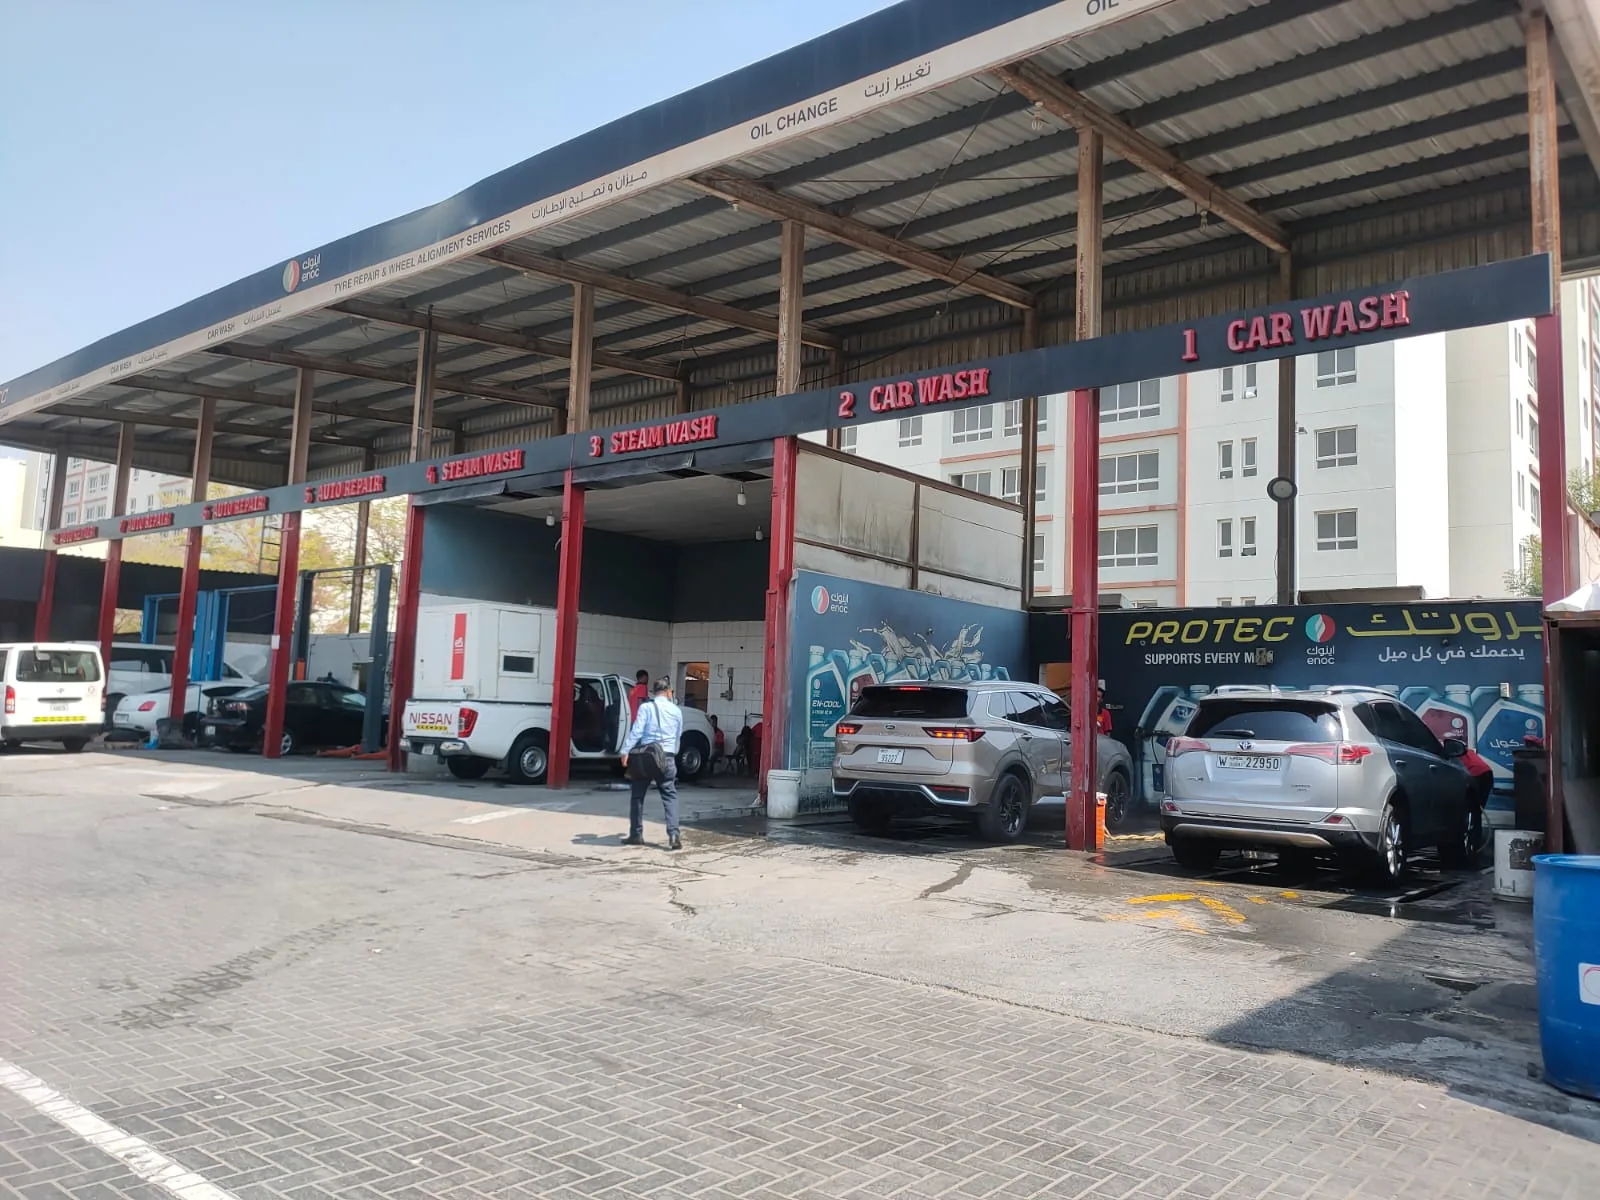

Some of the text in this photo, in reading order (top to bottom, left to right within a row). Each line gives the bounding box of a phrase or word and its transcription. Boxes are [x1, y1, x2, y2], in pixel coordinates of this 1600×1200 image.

[864, 61, 931, 98] تغيير زيت
[750, 97, 838, 140] OIL CHANGE
[334, 220, 511, 293] TYRE REPAIR & WHEEL ALIGNMENT SERVICES
[302, 268, 319, 282] enoc
[207, 322, 235, 340] CAR WASH
[1182, 290, 1410, 361] 1 CAR WASH
[838, 368, 990, 418] 2 CAR WASH
[589, 415, 717, 457] 3 STEAM WASH
[441, 456, 483, 480] STEAM
[483, 449, 523, 475] WASH
[317, 482, 345, 501] AUTO
[344, 475, 385, 497] REPAIR
[831, 604, 848, 614] enoc
[1125, 617, 1295, 644] PROTEC
[1145, 652, 1201, 665] SUPPORTS
[1205, 652, 1240, 664] EVERY
[1306, 657, 1335, 665] enoc
[1378, 645, 1525, 664] يدعمك في كل ميل
[409, 712, 453, 725] NISSAN
[1219, 756, 1227, 767] W
[1246, 757, 1279, 770] 22950
